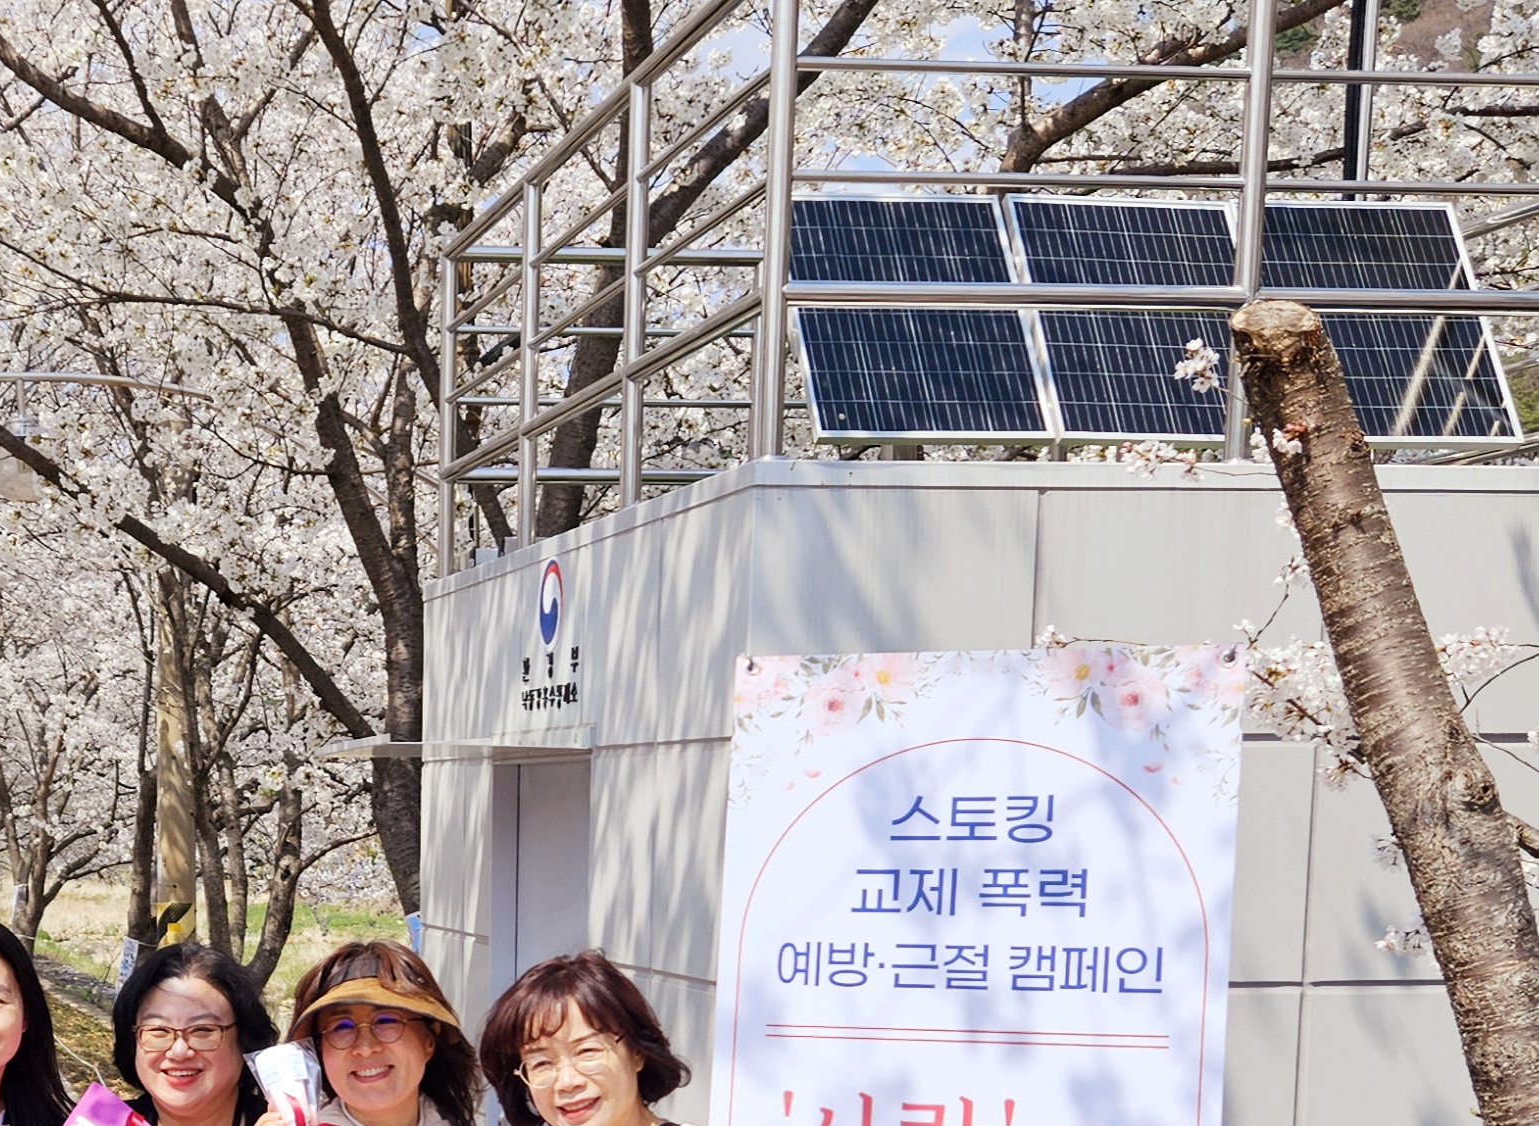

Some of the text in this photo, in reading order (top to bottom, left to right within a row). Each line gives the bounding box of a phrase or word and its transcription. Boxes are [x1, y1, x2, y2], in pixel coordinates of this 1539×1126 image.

[888, 795, 1054, 843] 스토킹
[851, 867, 1088, 917] 교제 폭력
[778, 942, 1163, 994] 예방·근절 캠페인
